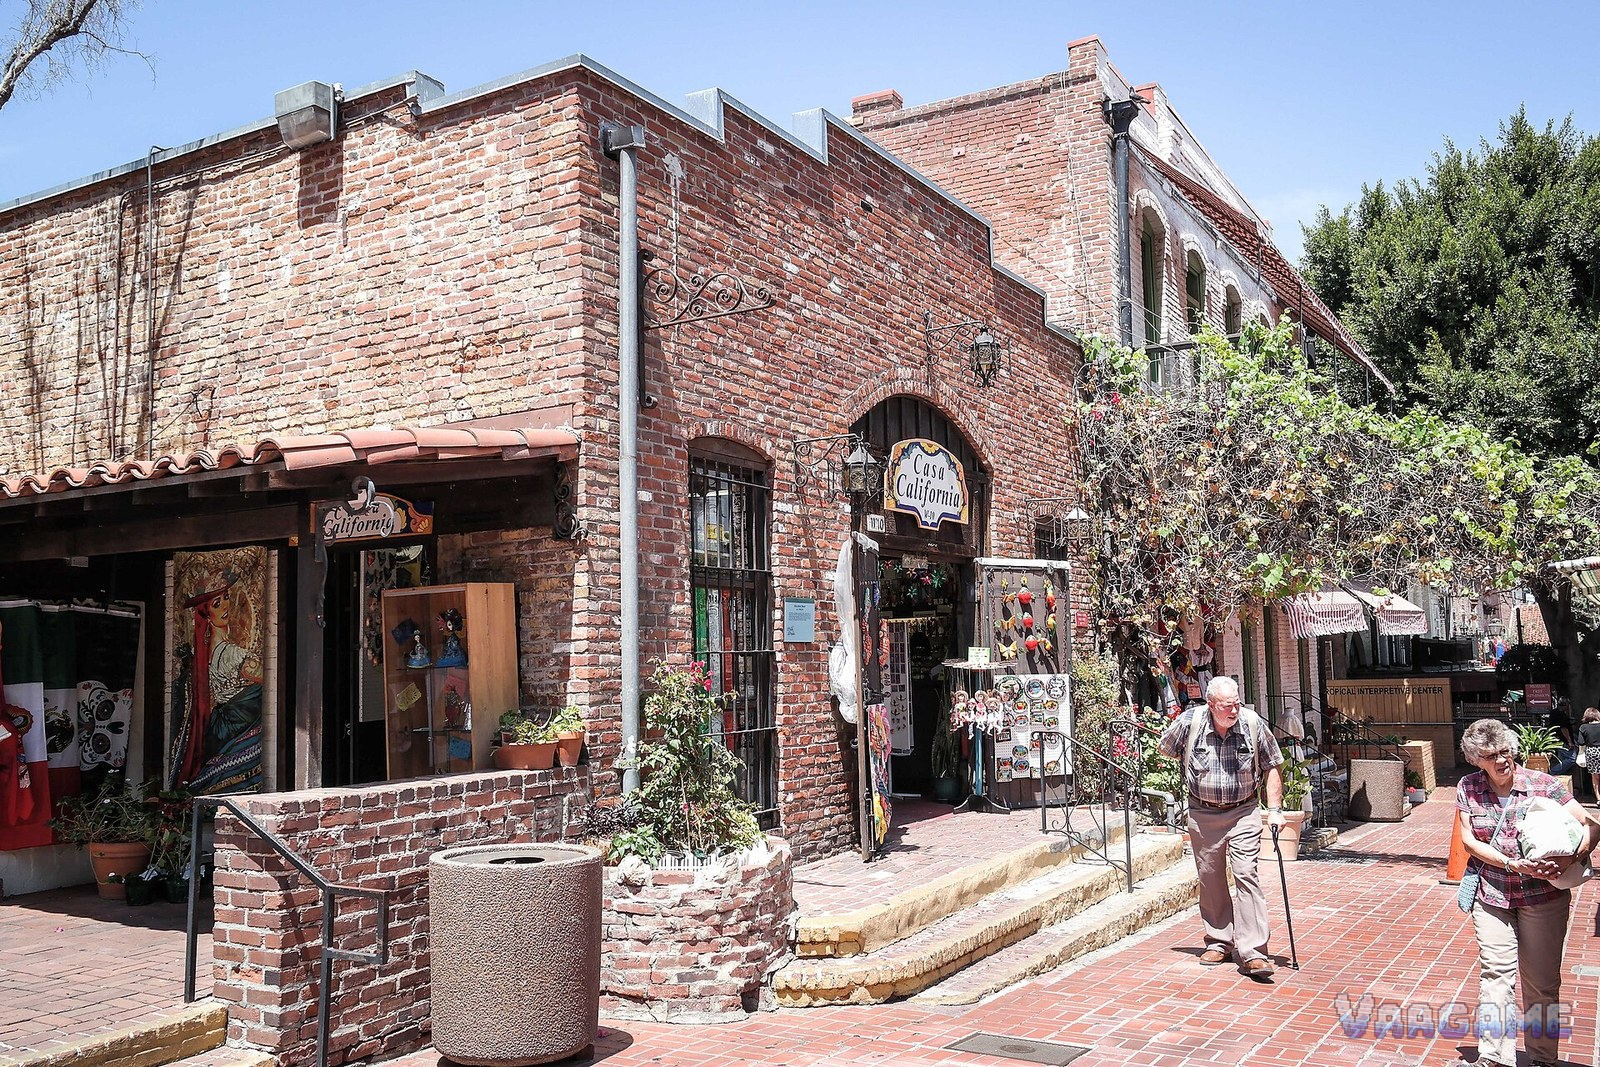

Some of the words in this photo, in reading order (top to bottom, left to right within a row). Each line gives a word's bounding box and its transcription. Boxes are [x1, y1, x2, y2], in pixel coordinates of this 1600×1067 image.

[913, 453, 945, 480] Casa
[896, 473, 960, 508] California
[333, 503, 380, 520] Ca
[1325, 687, 1356, 695] ROPICAL
[1357, 687, 1410, 695] INTERPRETIVE
[1412, 686, 1444, 694] CENTER
